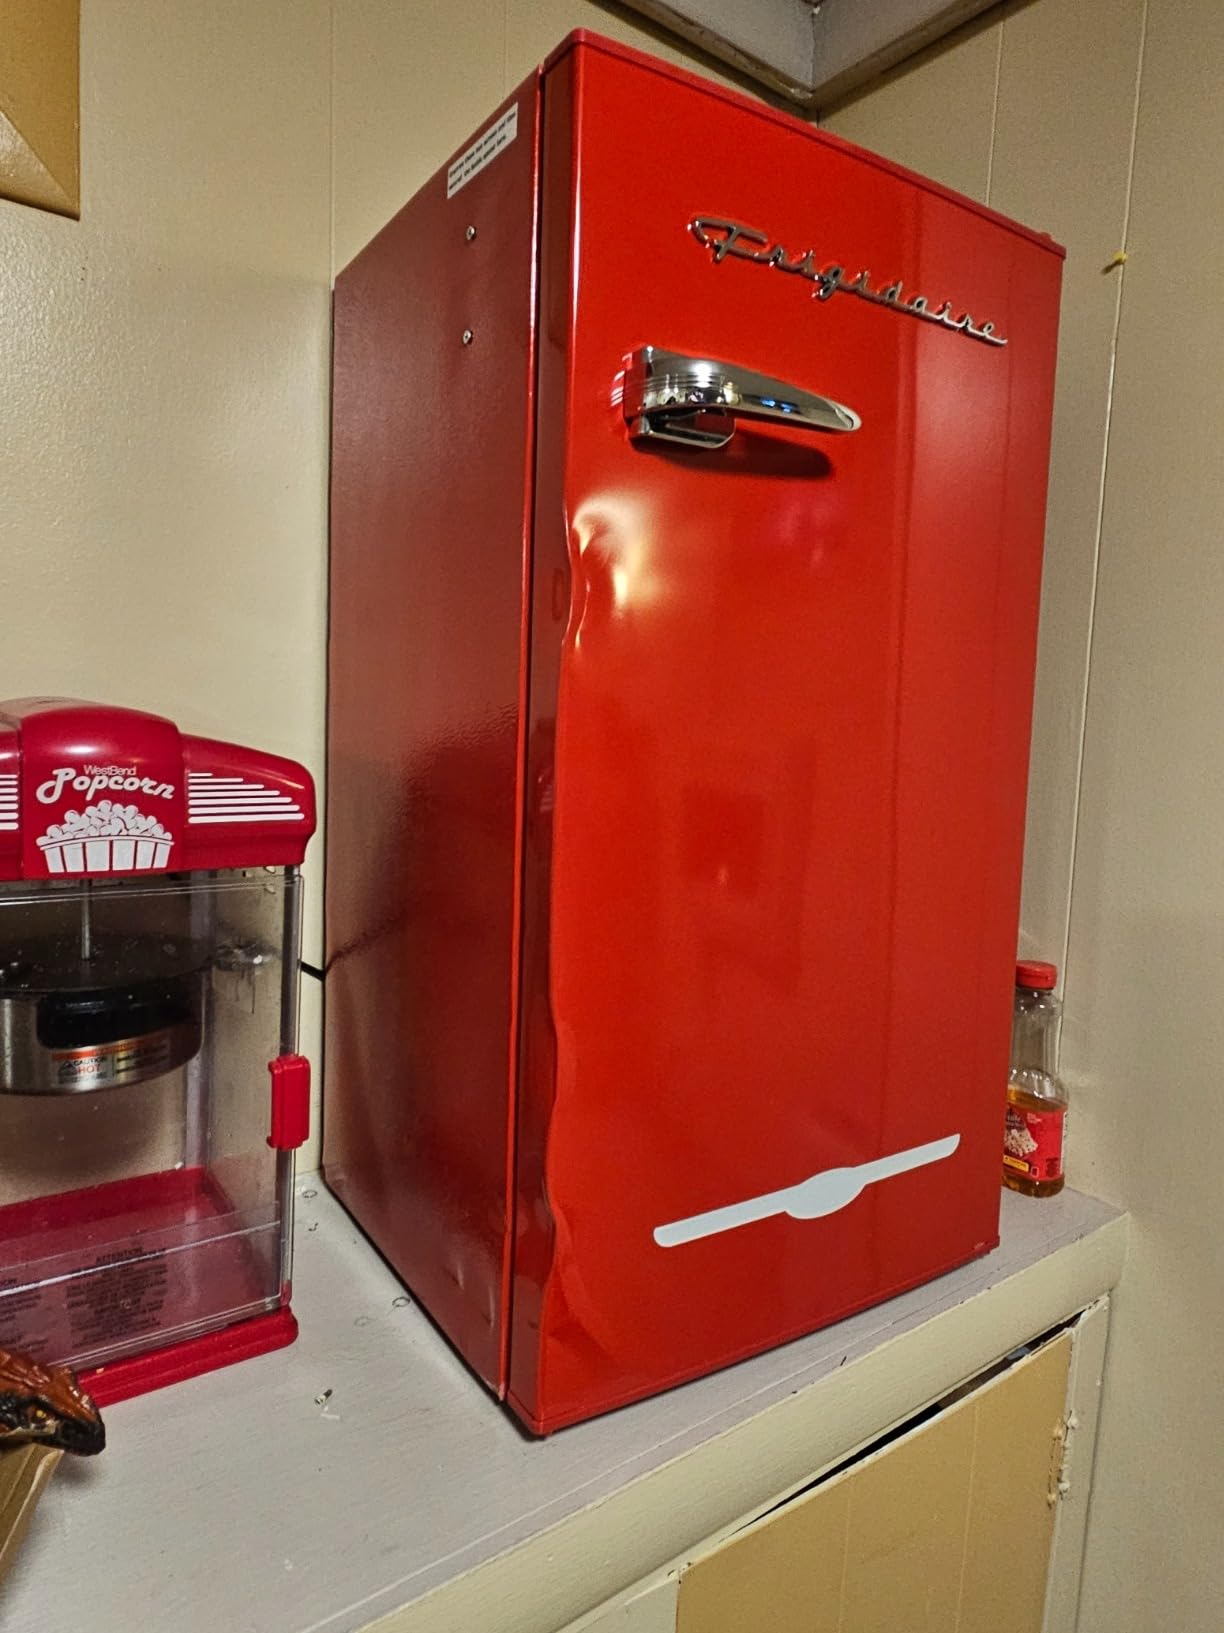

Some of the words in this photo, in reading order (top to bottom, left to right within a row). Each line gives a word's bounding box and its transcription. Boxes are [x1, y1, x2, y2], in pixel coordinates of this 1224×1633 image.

[687, 216, 1008, 346] Frigidaire
[36, 768, 175, 804] Popcorn
[78, 1064, 100, 1075] HOT
